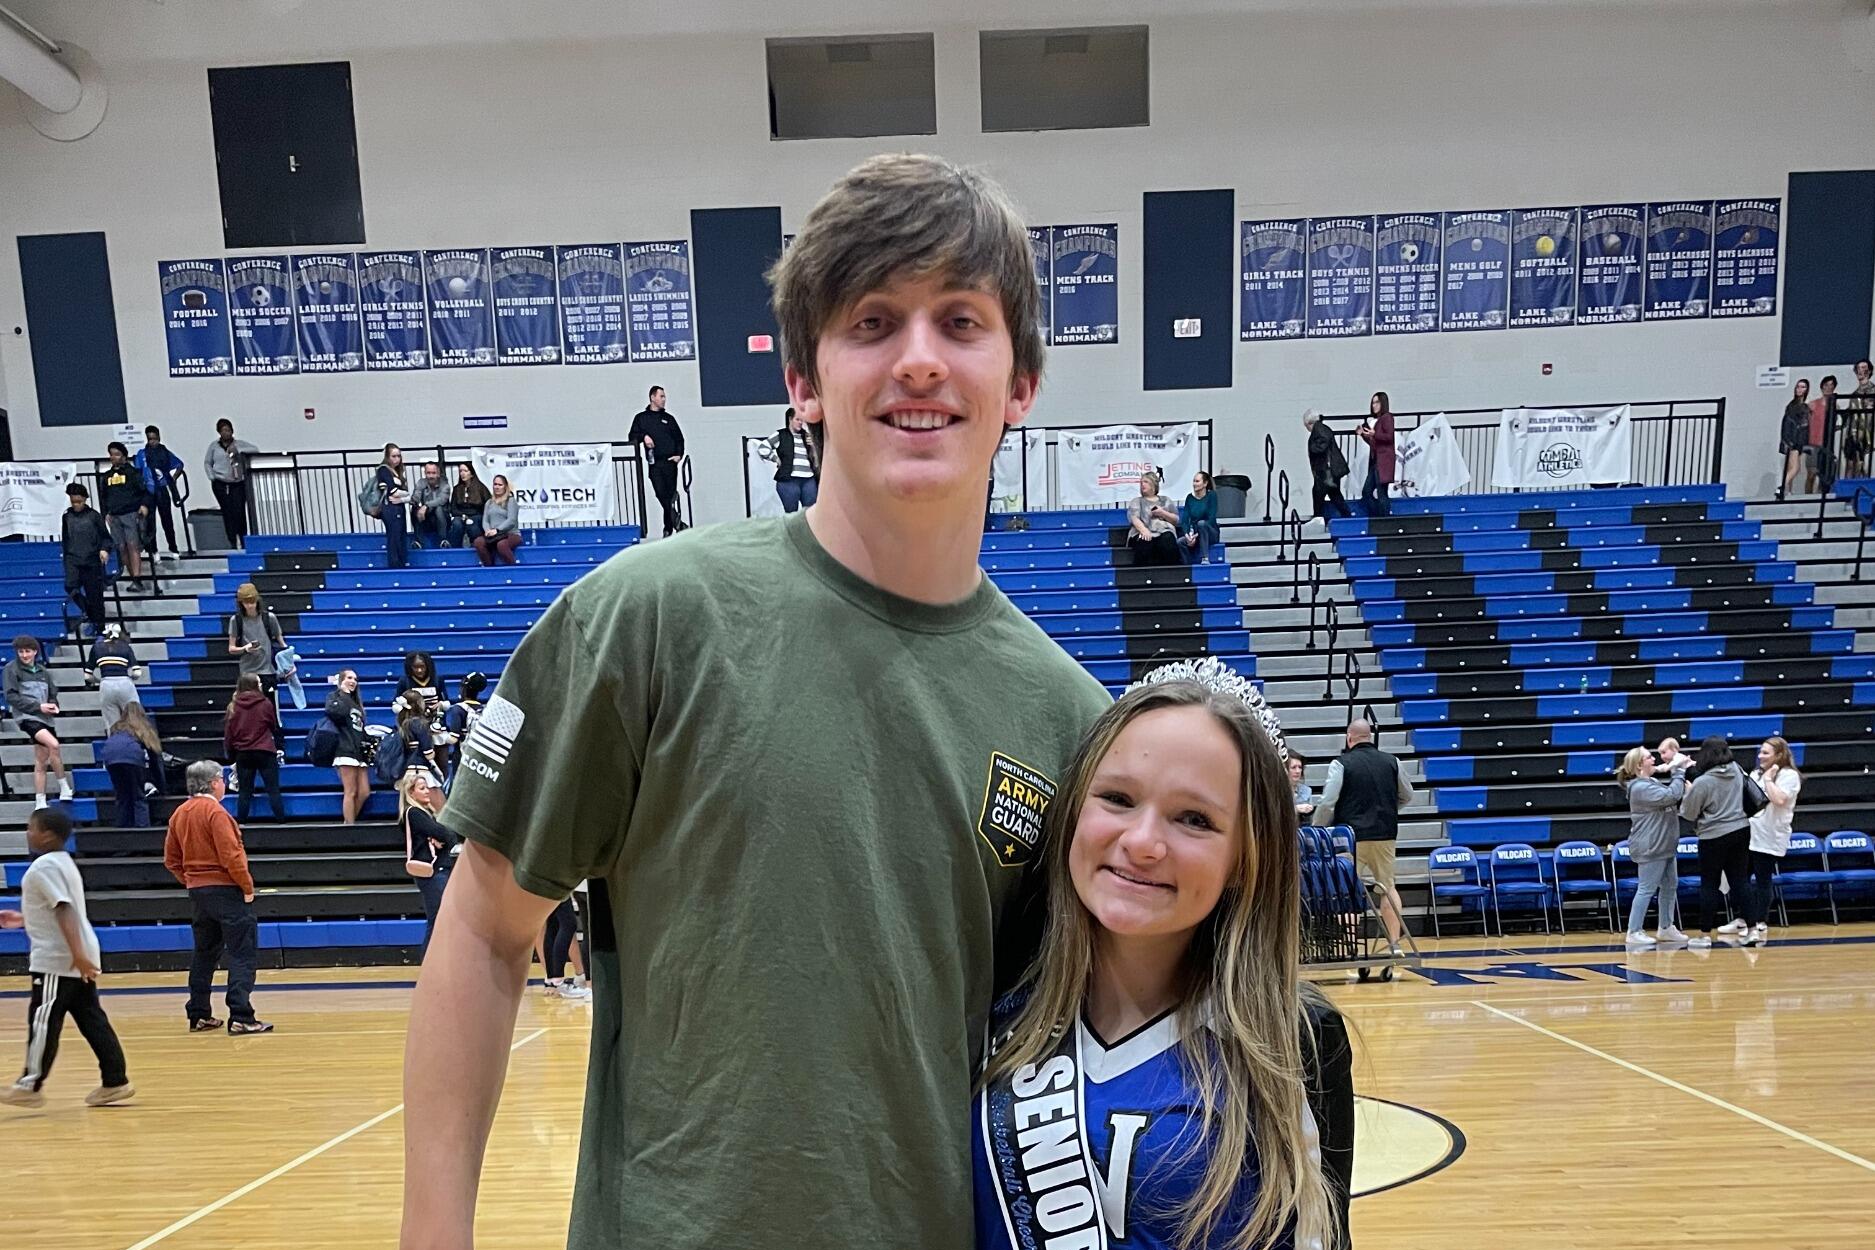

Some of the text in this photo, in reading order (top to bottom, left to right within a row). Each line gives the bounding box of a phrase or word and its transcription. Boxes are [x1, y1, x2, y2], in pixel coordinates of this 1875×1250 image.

[1658, 204, 1704, 214] CONFERENCE
[1721, 201, 1775, 213] CONFERENCE
[1523, 210, 1569, 220] CONFERENCE
[1588, 208, 1638, 219] CONFERENCE
[1385, 216, 1434, 228] CONFERENCE
[1452, 213, 1502, 225] CONFERENCE
[1252, 222, 1297, 233] CONFERENCE
[1316, 220, 1366, 231] CONFERENCE
[1064, 227, 1108, 237] CONFERENCE
[501, 249, 544, 259] CONFERENCE
[564, 248, 613, 260] CONFERENCE
[631, 244, 680, 256] CONFERENCE
[1647, 250, 1710, 260] GIRLS LACROSSE
[1738, 249, 1774, 257] LACROSSE
[364, 254, 413, 266] CONFERENCE
[433, 251, 478, 262] CONFERENCE
[1586, 256, 1637, 265] BASEBALL
[169, 261, 214, 272] CONFERENCE
[232, 260, 281, 271] CONFERENCE
[298, 256, 347, 268] CONFERENCE
[1450, 261, 1502, 270] MENS GOLF
[1521, 258, 1567, 267] SOFTBALL
[1312, 268, 1369, 277] BOYS TENNIS
[1378, 264, 1438, 273] WOMENS SOCCER
[1057, 276, 1082, 284] MENS
[1084, 275, 1114, 283] TRACK
[1244, 270, 1303, 280] GIRLS TRACK
[629, 292, 689, 301] LADIES SWIMMING
[363, 302, 423, 311] GIRLS TENNIS
[435, 299, 484, 308] VOLLEYBALL
[1654, 301, 1680, 309] LAKE
[1721, 299, 1748, 307] LAKE
[173, 309, 218, 318] FOOTBALL
[232, 307, 291, 316] MENS SOCCER
[299, 305, 330, 313] LADIES
[1588, 306, 1614, 314] LAKE
[1645, 310, 1689, 318] NORMAN
[1452, 312, 1478, 320] LAKE
[1511, 317, 1554, 325] NORMAN
[1579, 315, 1622, 323] NORMAN
[1064, 326, 1089, 334] LAKE
[1376, 323, 1419, 331] NORMAN
[1443, 321, 1486, 329] NORMAN
[1242, 330, 1285, 338] NORMAN
[1309, 327, 1352, 335] NORMAN
[442, 349, 467, 357] LAKE
[567, 354, 609, 362] NORMAN
[633, 351, 676, 359] NORMAN
[303, 362, 345, 370] NORMAN
[368, 360, 410, 368] NORMAN
[1540, 449, 1580, 462] COMBAT
[1099, 462, 1151, 479] JETTING
[1537, 459, 1583, 472] ATHLETICS
[551, 489, 595, 501] TECH
[996, 758, 1055, 796] NORTH CAROLINA
[998, 777, 1049, 814] ARMY
[994, 792, 1042, 829] NATIONAL
[992, 806, 1039, 845] GUARD
[1831, 838, 1866, 848] WILDCATS
[1498, 850, 1532, 860] WILDCATS
[1561, 847, 1595, 857] WILDCATS
[1436, 852, 1470, 863] WILDCATS
